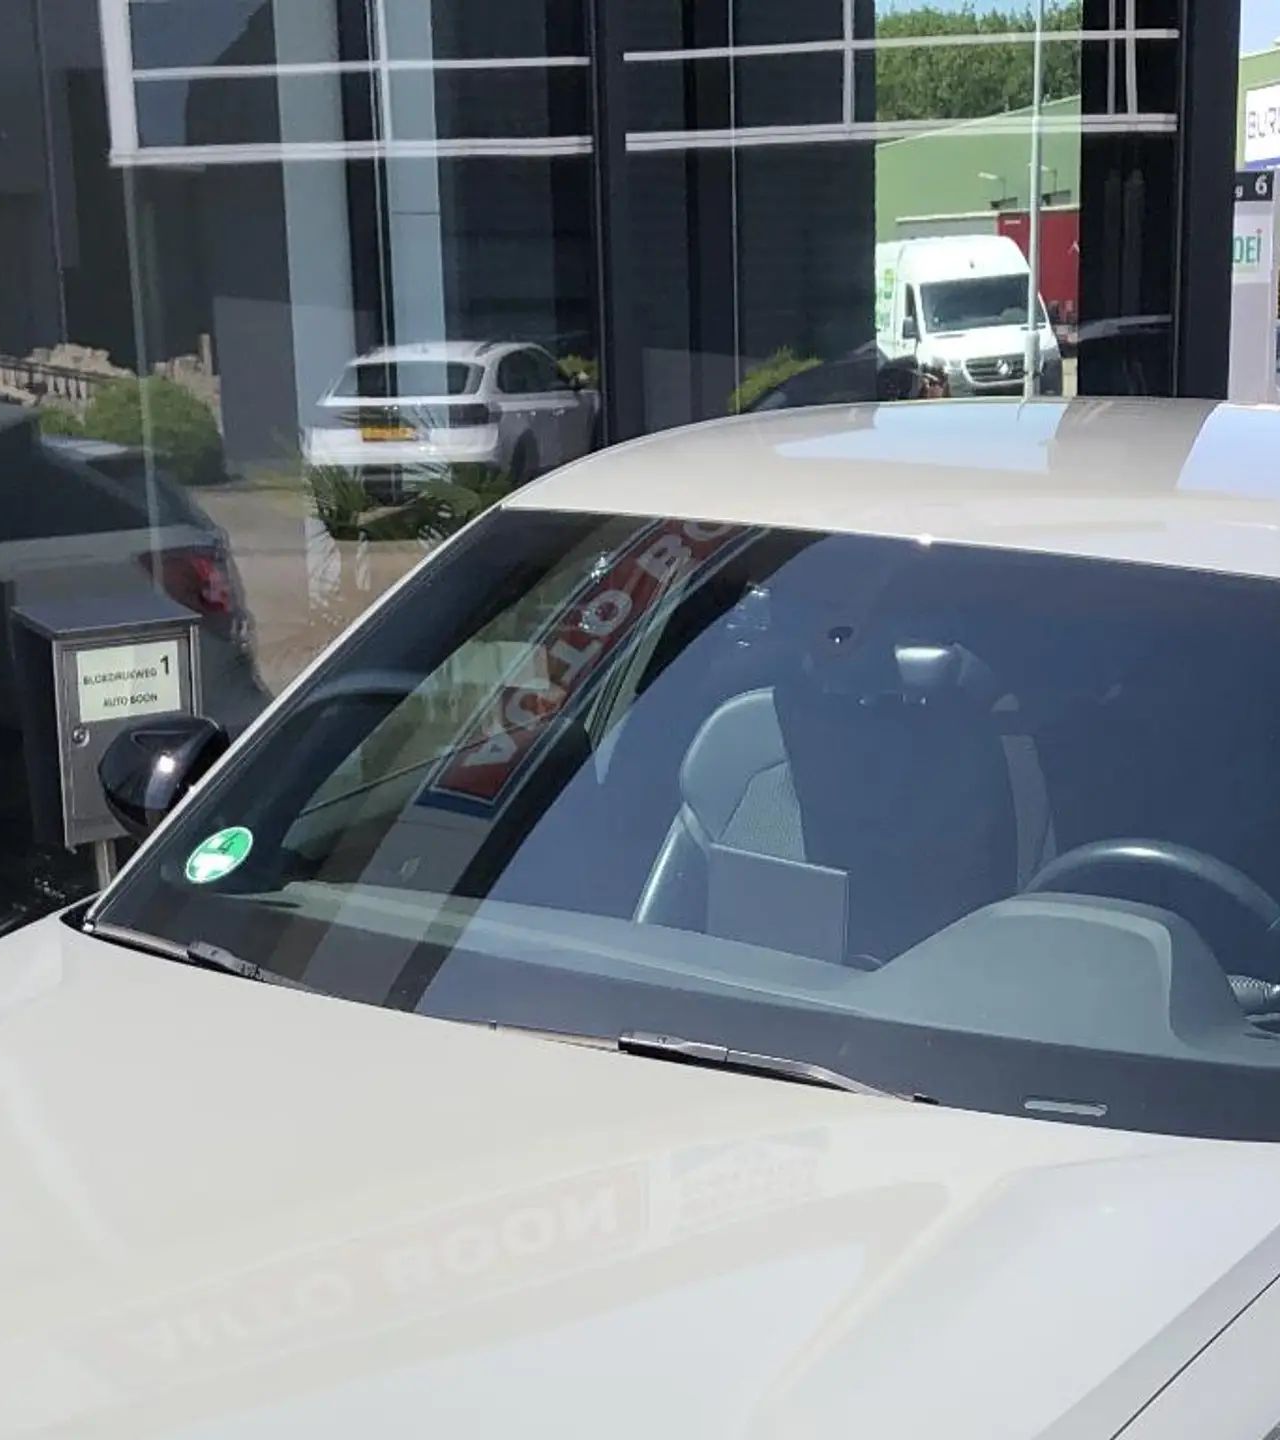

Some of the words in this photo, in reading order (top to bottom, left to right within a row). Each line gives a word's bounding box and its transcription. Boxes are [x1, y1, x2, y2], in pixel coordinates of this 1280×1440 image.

[1255, 174, 1268, 197] 6
[159, 654, 171, 676] 1
[103, 695, 129, 708] AUTO
[130, 692, 159, 705] BOON
